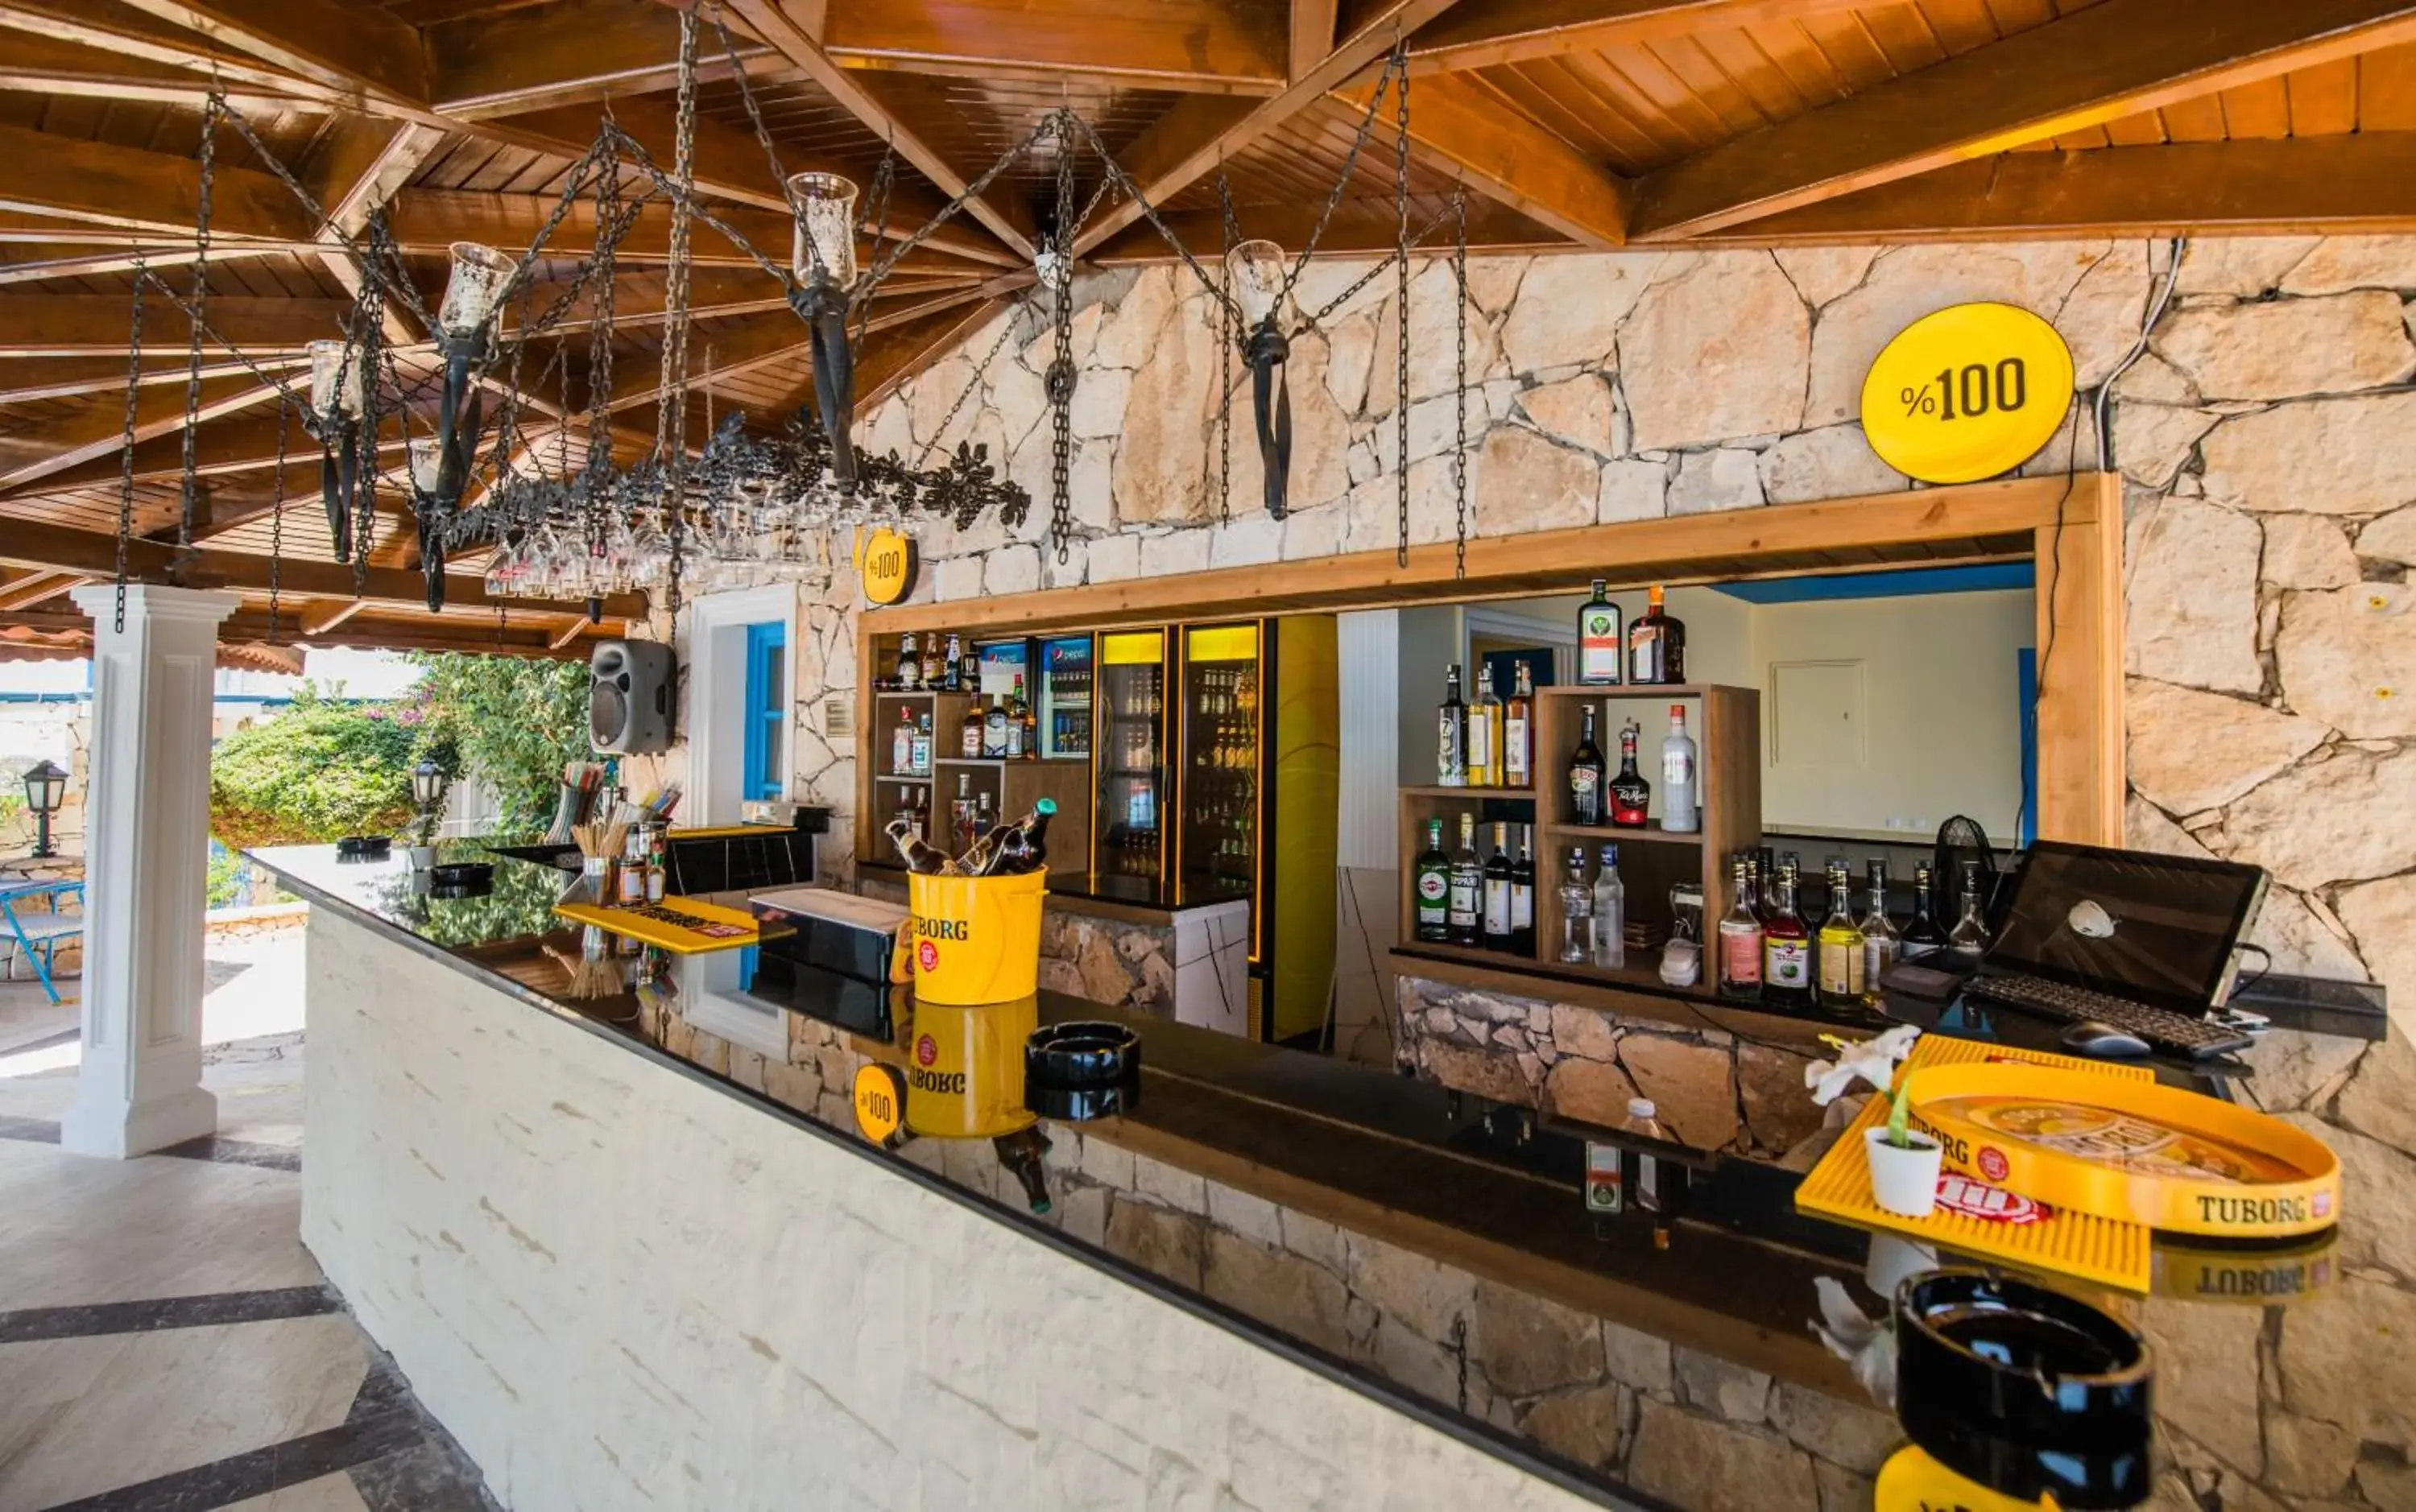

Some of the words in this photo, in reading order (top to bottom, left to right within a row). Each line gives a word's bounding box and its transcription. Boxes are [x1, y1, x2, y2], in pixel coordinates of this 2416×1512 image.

[1901, 357, 2025, 421] %100
[869, 550, 900, 580] %100
[915, 916, 968, 941] BORG
[2197, 1194, 2306, 1224] TUBORG
